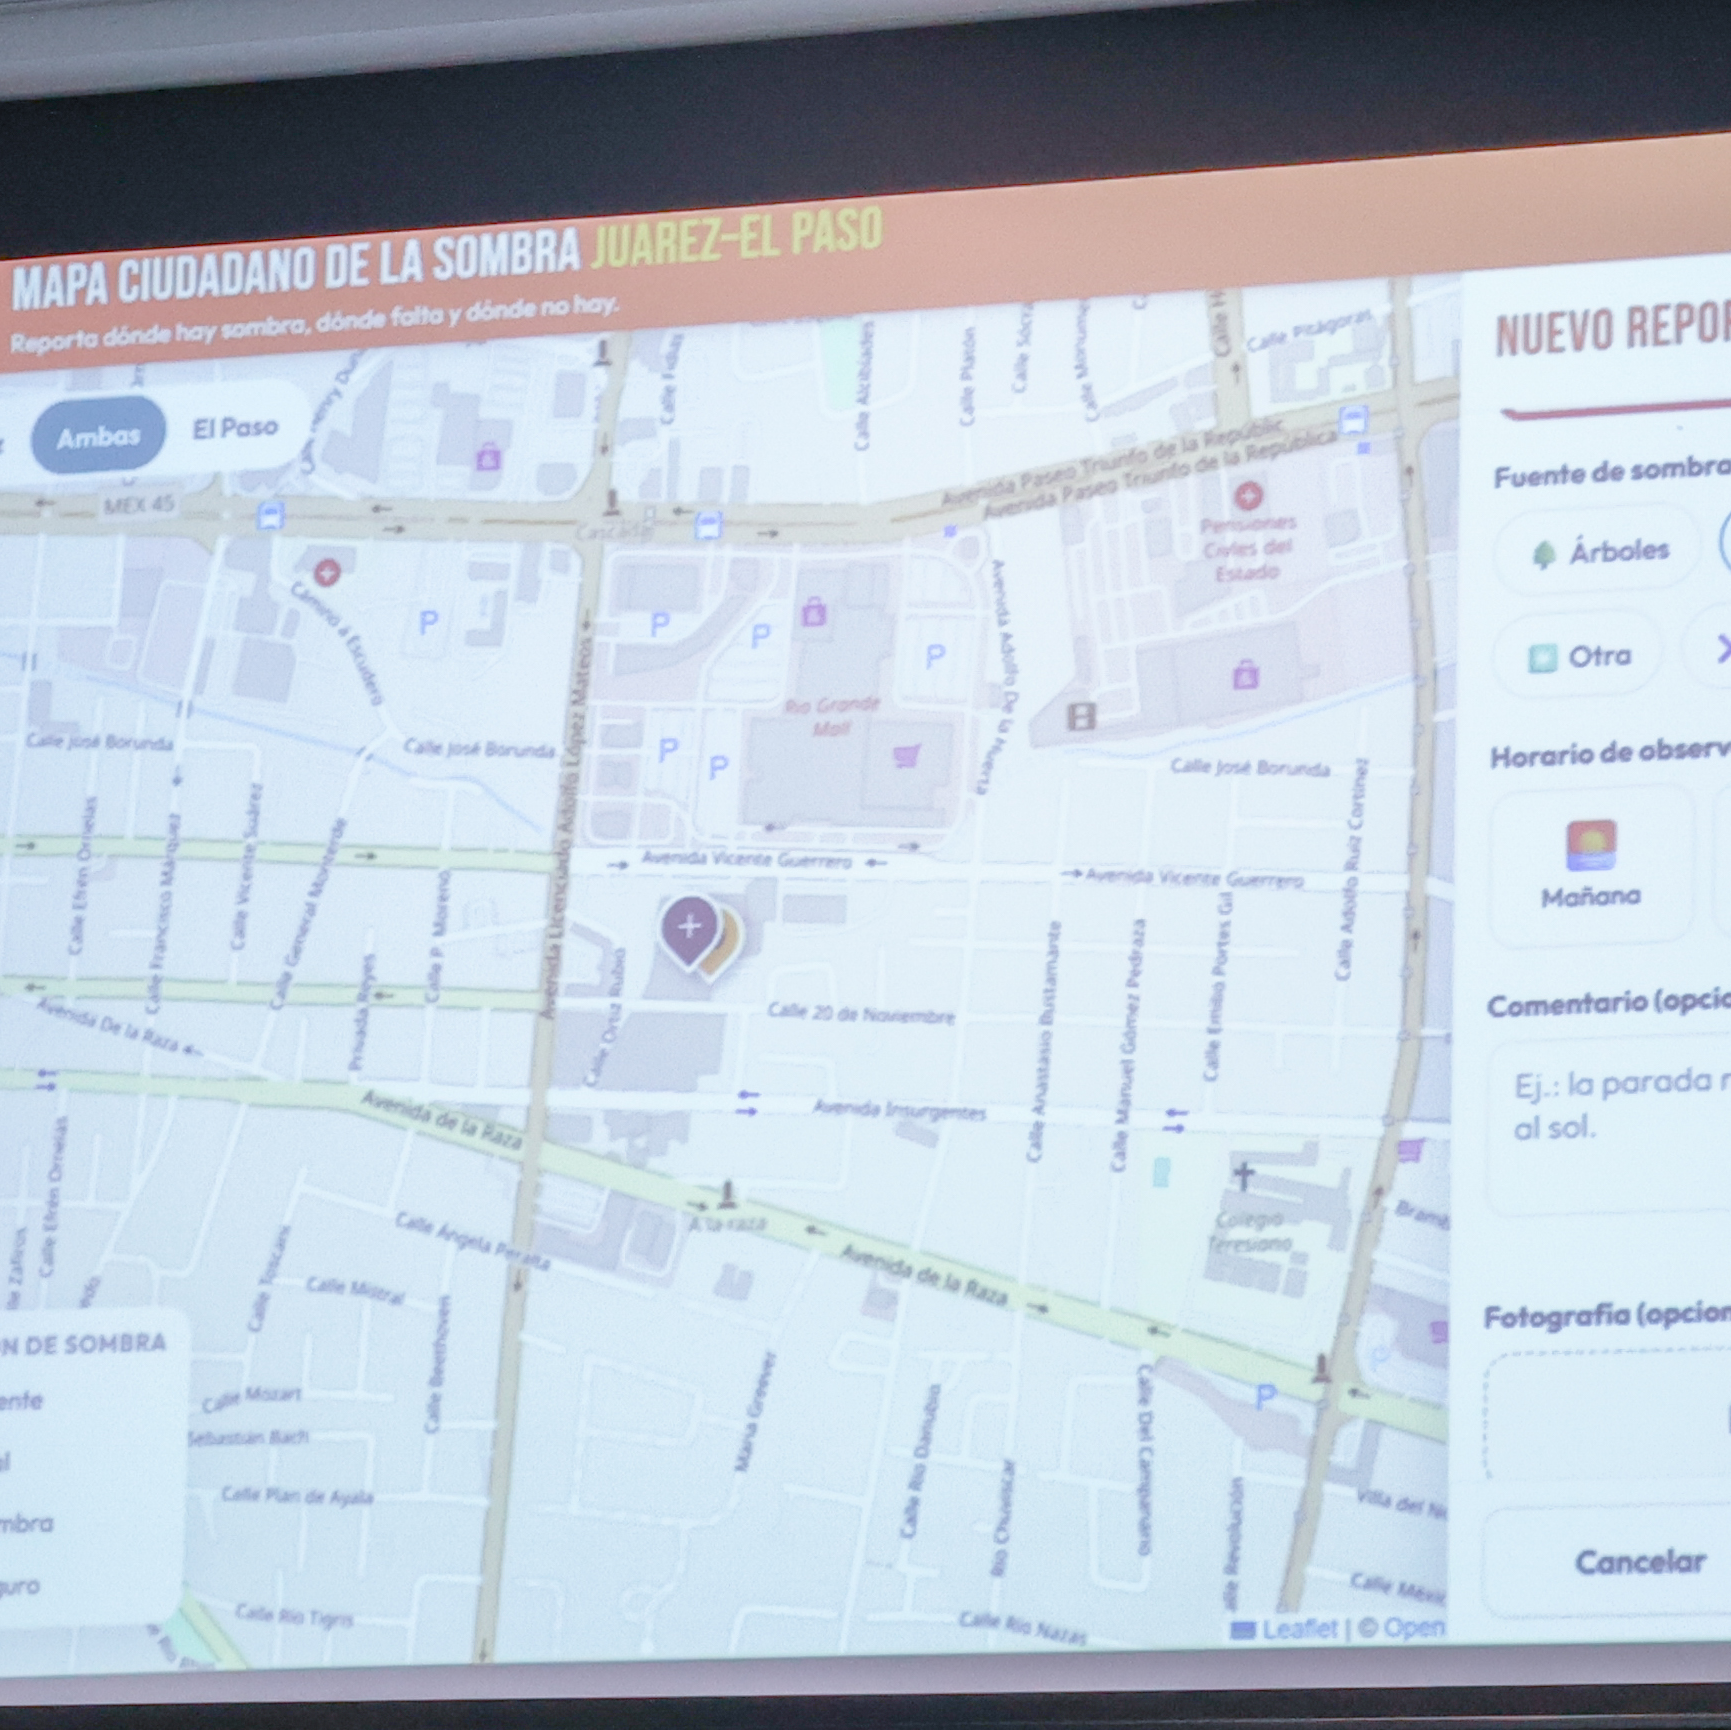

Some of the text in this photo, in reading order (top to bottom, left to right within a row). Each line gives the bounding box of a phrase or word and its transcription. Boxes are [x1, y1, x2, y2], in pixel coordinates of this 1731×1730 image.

[12, 261, 108, 311] MAPA
[119, 246, 317, 303] CIUDADANO
[325, 241, 370, 289] DE
[380, 238, 424, 285] LA
[433, 226, 581, 281] SOMBRA
[792, 206, 883, 254] PASO
[10, 294, 619, 357] Reporta dónde hay sombra, dónde falta y dónde no hay.
[1496, 307, 1614, 357] NUEVO
[56, 427, 141, 450] Ambas
[193, 417, 279, 439] El Paso
[1195, 457, 1218, 473] de
[1224, 451, 1240, 466] la
[1495, 464, 1585, 489] Fuente
[1592, 460, 1625, 482] de
[104, 495, 147, 516] MEX
[1569, 534, 1669, 565] Árboles
[1216, 565, 1280, 583] Estado
[1569, 644, 1632, 668] Otra
[403, 738, 443, 756] Calle
[1491, 743, 1594, 769] Horario
[1600, 740, 1632, 763] de
[1171, 757, 1212, 774] Calle
[642, 849, 707, 866] Avenida
[1085, 867, 1154, 885] Avenida
[1542, 885, 1641, 908] Mañana
[230, 910, 249, 950] Calle
[1334, 938, 1354, 981] Calle
[145, 973, 163, 1014] Calle
[270, 971, 293, 1010] Calle
[1202, 1039, 1221, 1082] Calle
[1217, 891, 1233, 916] Gil
[768, 1001, 808, 1020] Calle
[812, 1004, 833, 1021] 20
[838, 1007, 858, 1022] de
[1487, 990, 1649, 1018] Comentario
[1568, 1070, 1593, 1097] la
[1602, 1066, 1713, 1100] parada
[361, 1089, 522, 1150] Avenida de la Raza
[812, 1099, 881, 1118] Avenida
[1514, 1113, 1597, 1141] al sol.
[1025, 1121, 1046, 1164] Calle
[1110, 1130, 1128, 1173] Calle
[840, 1244, 1008, 1307] Avenida de la Raza
[26, 1336, 58, 1356] DE
[64, 1333, 166, 1355] SOMBRA
[1137, 1363, 1153, 1406] Calle
[222, 1485, 260, 1501] Calle
[305, 1489, 325, 1504] de
[1575, 1548, 1707, 1575] Cancelar
[1263, 1619, 1340, 1640] Leaflet
